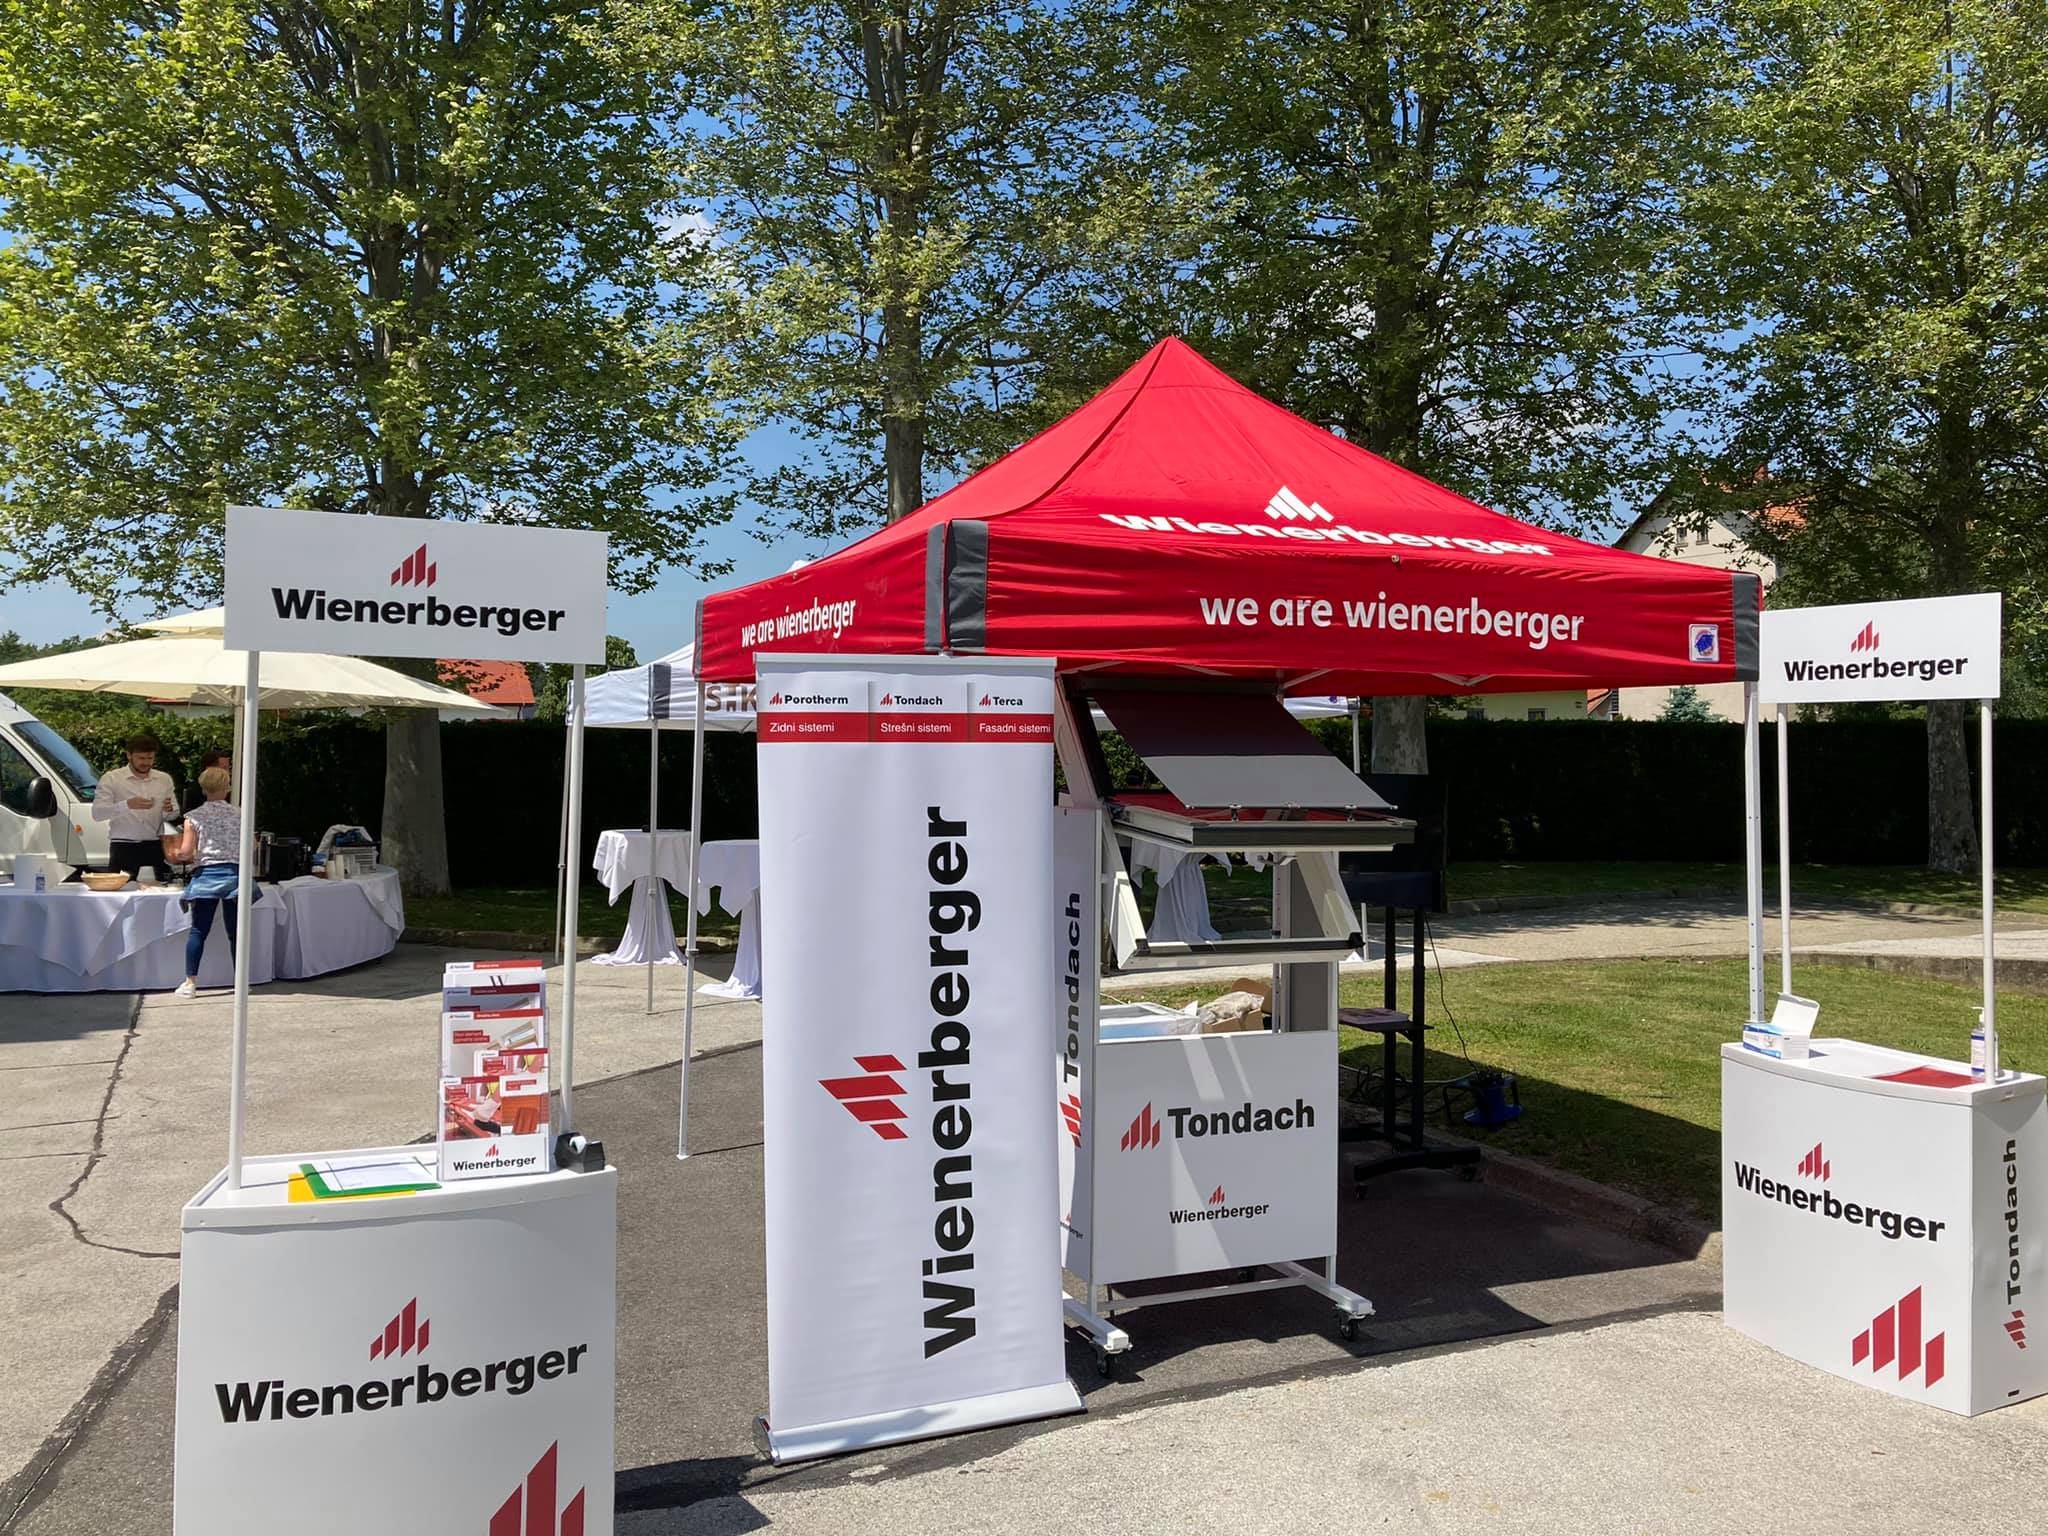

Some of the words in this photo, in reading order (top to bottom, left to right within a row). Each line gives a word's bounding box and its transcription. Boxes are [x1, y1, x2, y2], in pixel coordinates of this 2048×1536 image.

[1099, 513, 1554, 556] Wienerberger
[271, 587, 566, 637] Wienerberger
[741, 623, 756, 648] we
[757, 618, 774, 645] are
[776, 596, 856, 639] wienerberger
[1199, 597, 1259, 626] we
[1269, 598, 1333, 627] are
[1342, 591, 1585, 650] wienerberger
[1783, 656, 1969, 682] Wienerberger
[784, 694, 849, 705] Porotherm
[894, 695, 943, 706] Tondach
[992, 696, 1023, 706] Terca
[769, 722, 796, 733] Zidni
[798, 722, 835, 733] sistemi
[880, 721, 915, 733] Strešni
[917, 723, 952, 733] sistemi
[979, 722, 1017, 733] Fasadni
[1018, 723, 1050, 733] sistemi
[1063, 892, 1081, 1083] Tondach
[918, 806, 982, 1359] Wienerberger
[1167, 1098, 1315, 1139] Tondach
[453, 1157, 536, 1172] Wienerberger
[1169, 1203, 1270, 1224] Wienerberger
[1734, 1161, 1945, 1242] Wienerberger
[2003, 1139, 2021, 1305] Tondach
[214, 1343, 588, 1423] Wienerberger
